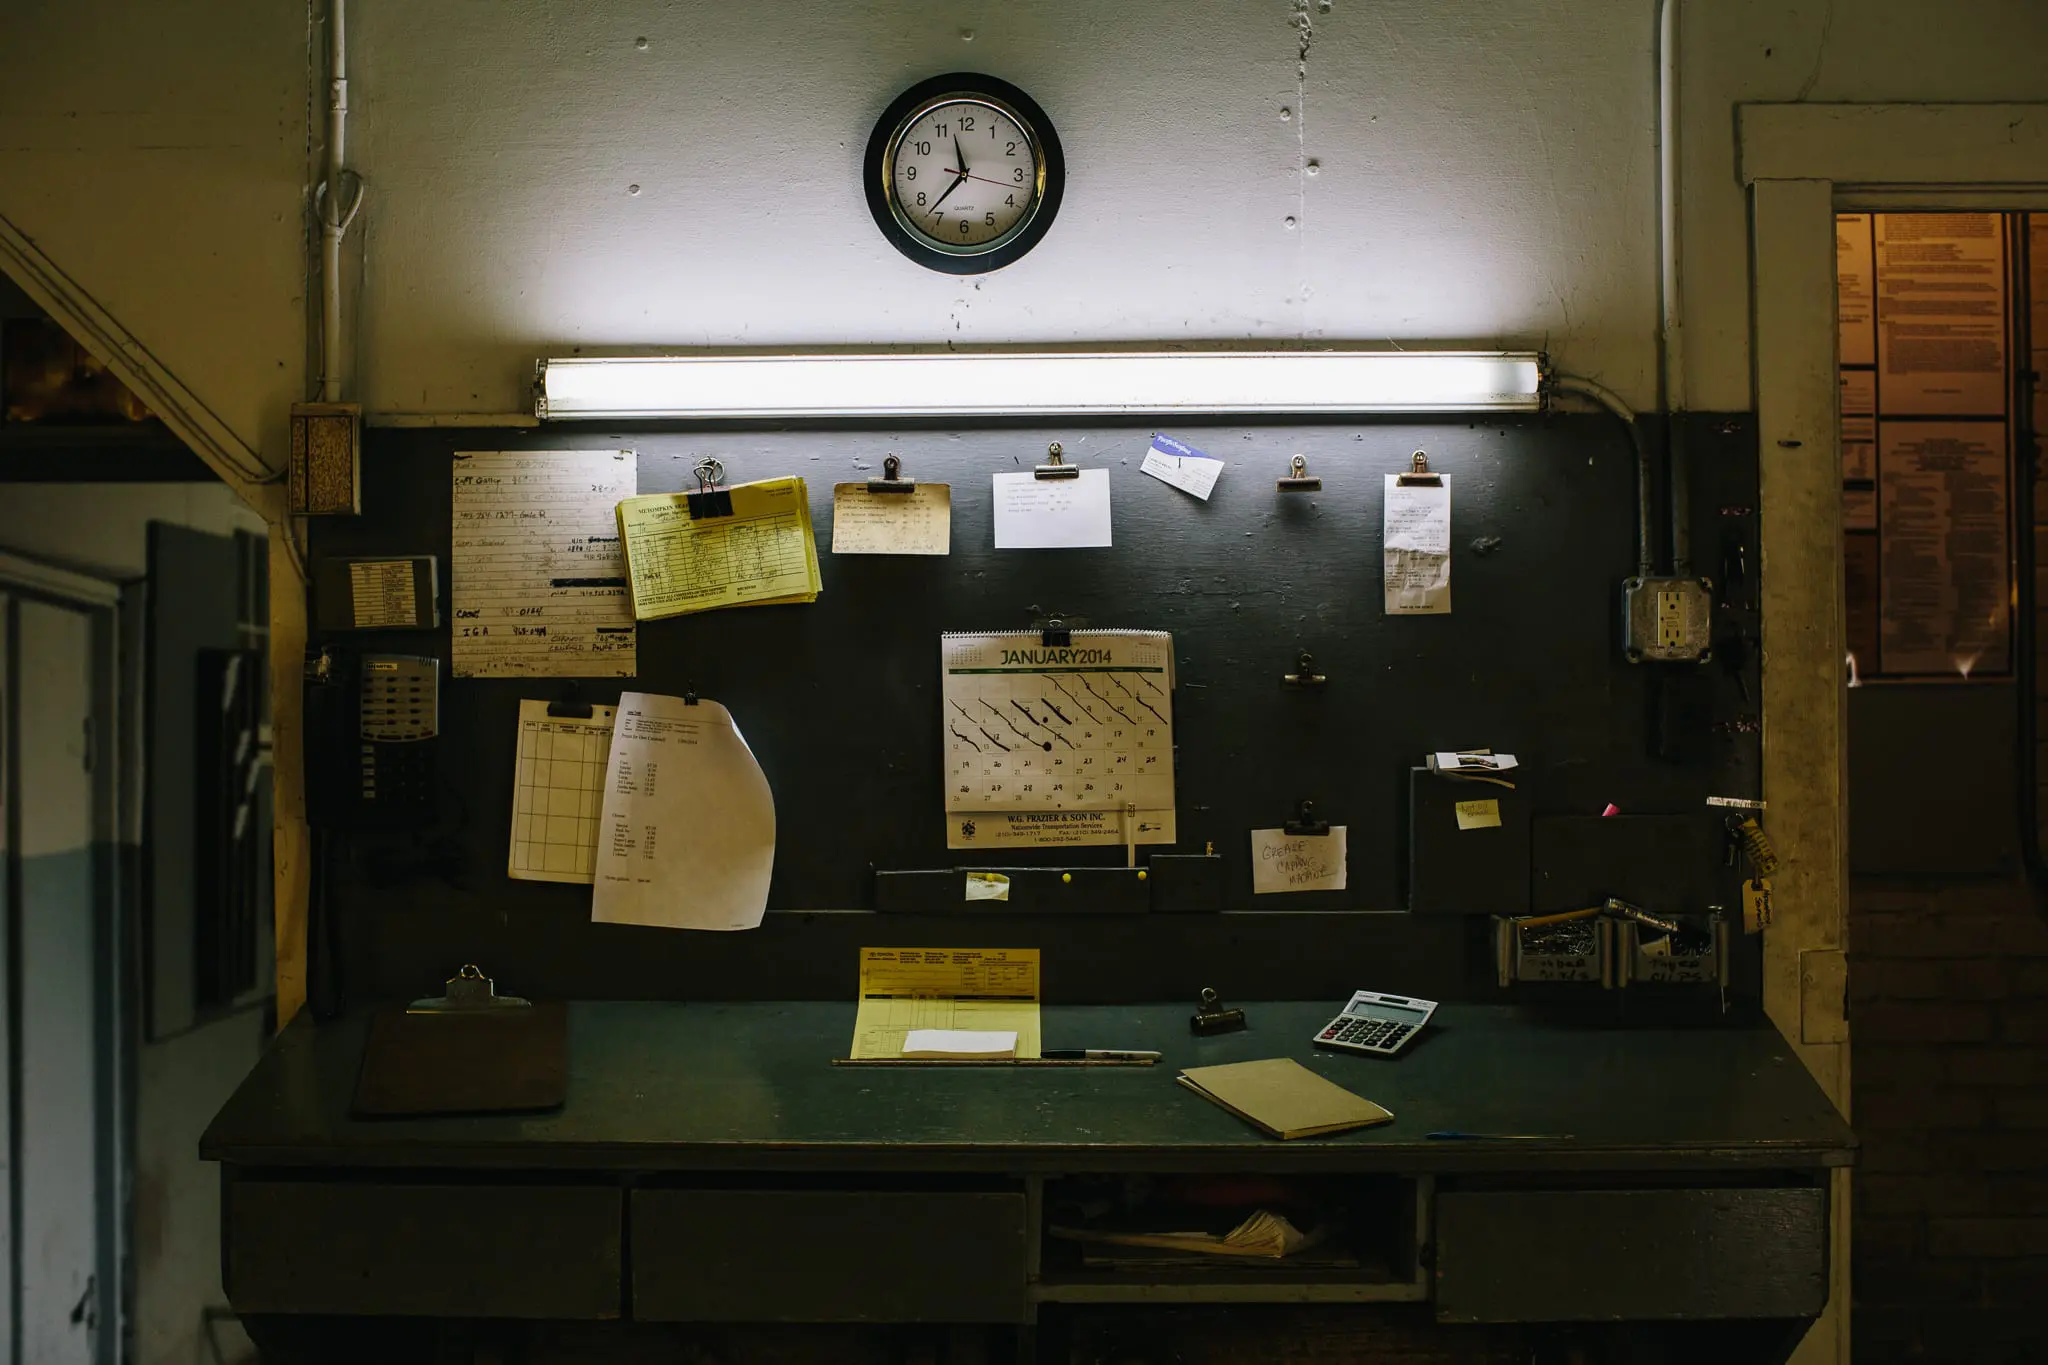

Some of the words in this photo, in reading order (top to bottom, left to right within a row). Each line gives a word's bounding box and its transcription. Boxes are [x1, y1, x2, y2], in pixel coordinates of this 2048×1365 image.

[935, 124, 948, 138] 11
[958, 117, 974, 131] 12
[989, 125, 995, 138] 1
[914, 142, 931, 156] 10
[1006, 142, 1016, 156] 2
[907, 166, 916, 180] 9
[1014, 168, 1024, 182] 3
[916, 192, 926, 206] 8
[1004, 194, 1014, 208] 4
[934, 212, 944, 226] 7
[986, 212, 995, 226] 5
[960, 220, 969, 234] 6
[1026, 814, 1060, 822] FRAZIER
[1070, 813, 1088, 822] SON
[1090, 812, 1106, 821] INC.
